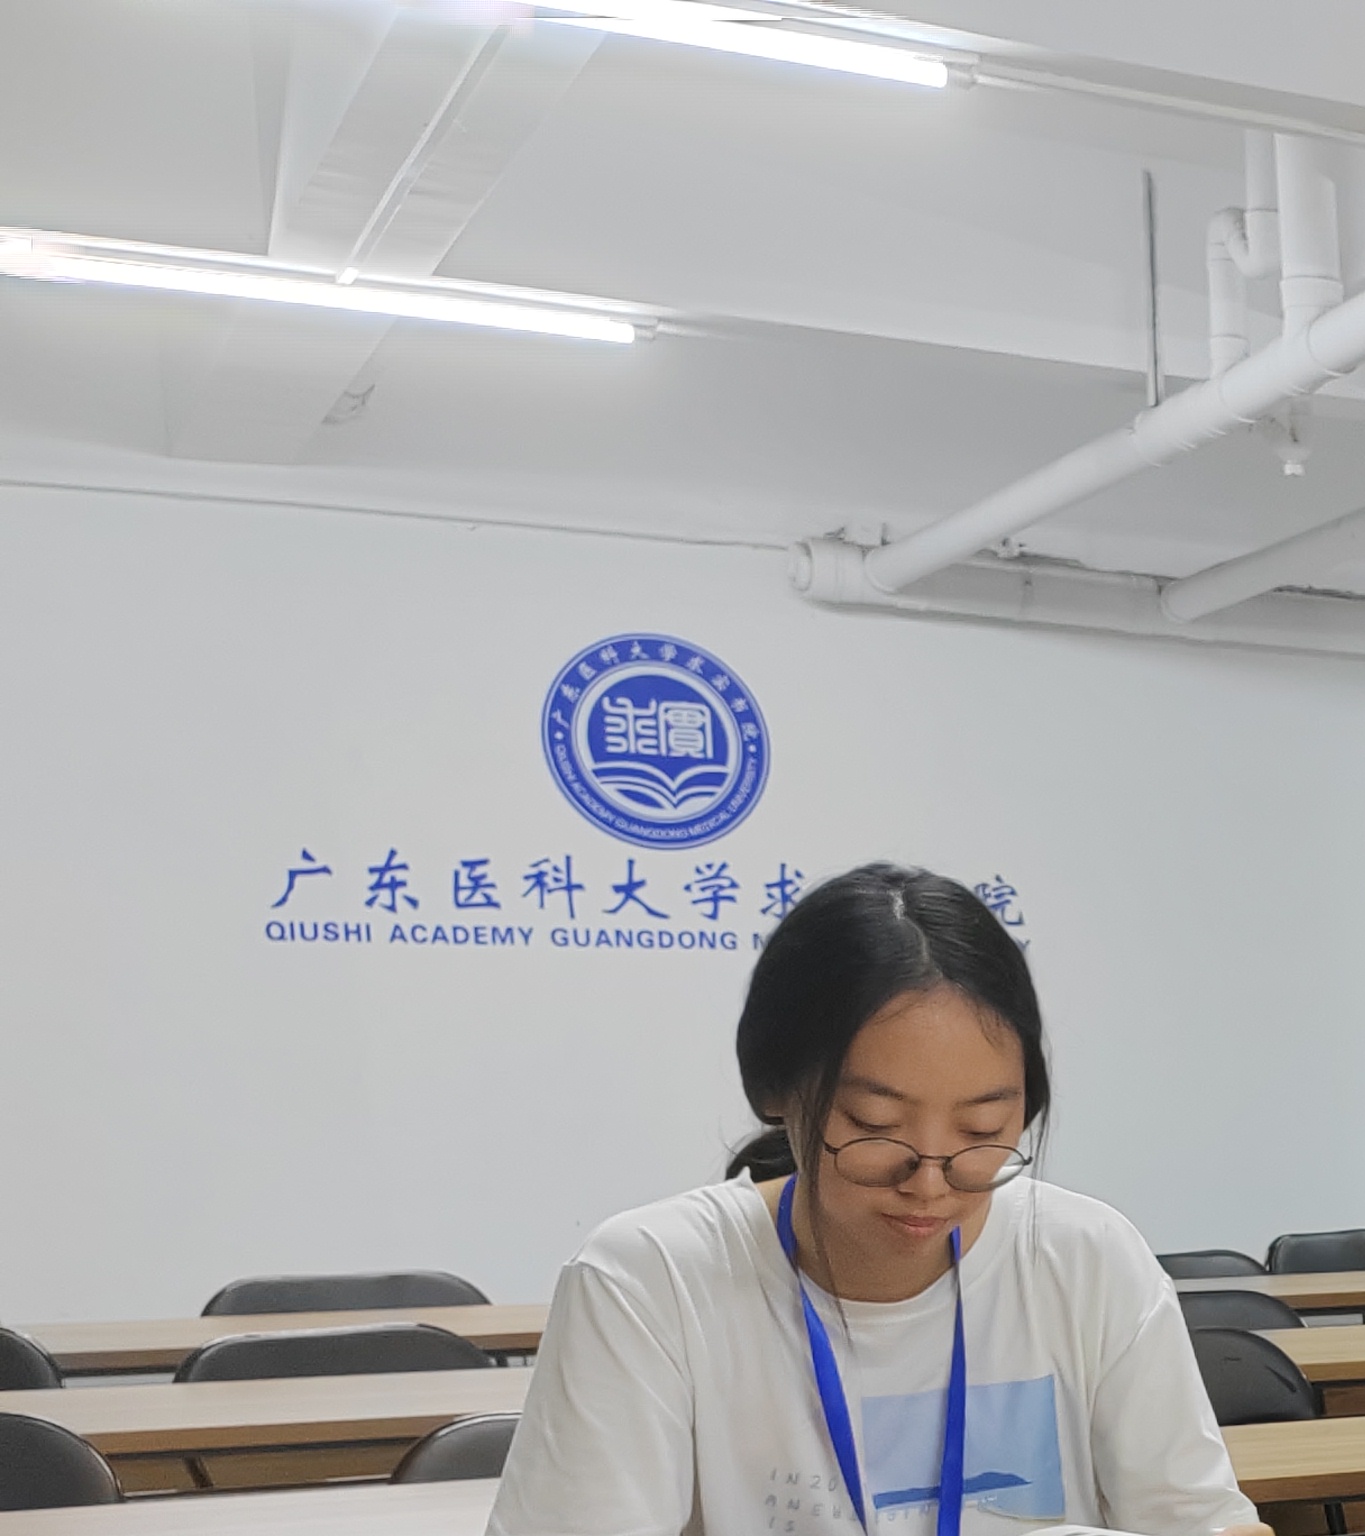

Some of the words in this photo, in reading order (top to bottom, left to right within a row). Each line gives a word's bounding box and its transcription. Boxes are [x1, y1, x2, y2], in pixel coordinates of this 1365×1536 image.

[265, 920, 372, 944] QIUSHI
[389, 924, 534, 948] ACADEMY
[550, 928, 739, 951] GUANGDONG
